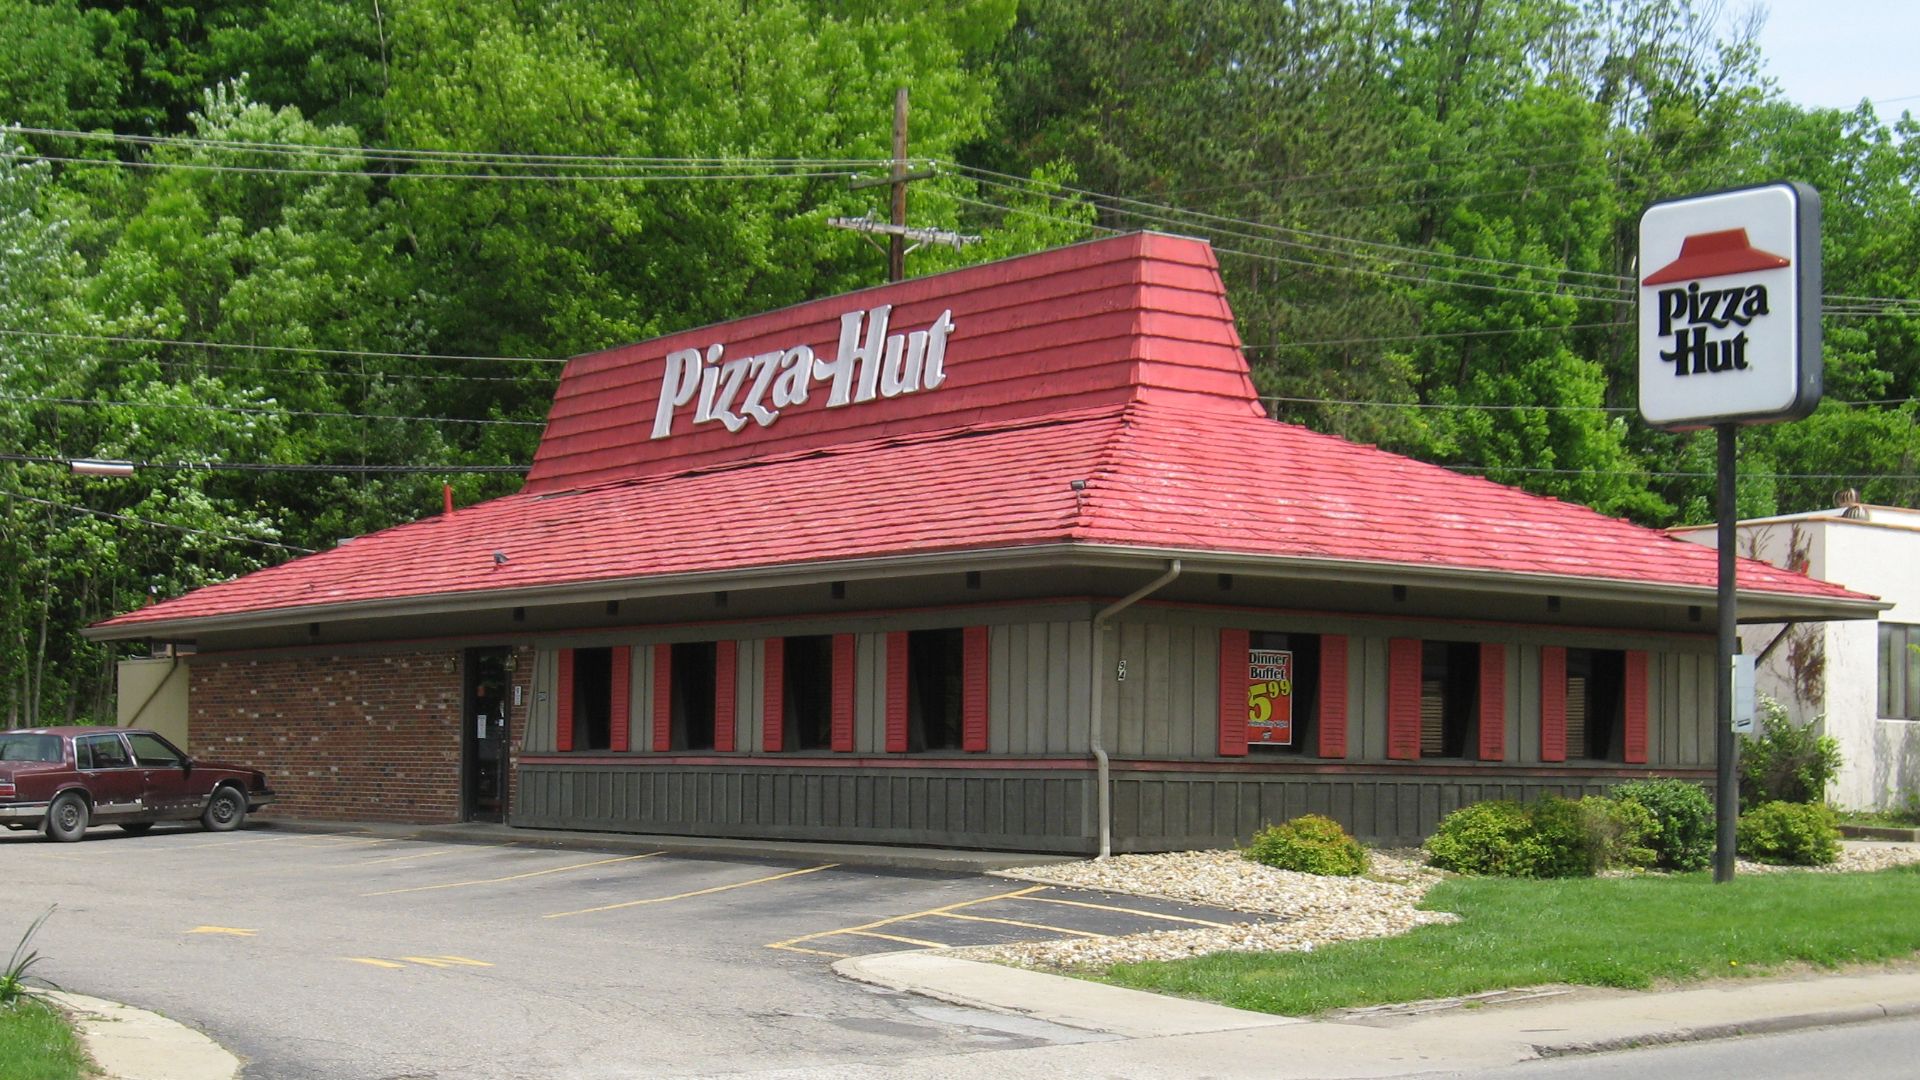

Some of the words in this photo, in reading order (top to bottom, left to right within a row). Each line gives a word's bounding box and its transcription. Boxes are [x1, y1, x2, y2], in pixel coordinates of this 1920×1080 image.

[1658, 281, 1769, 336] Pizza
[650, 343, 814, 439] Pizza
[813, 304, 955, 408] Hut
[1659, 326, 1749, 376] Hut
[1249, 653, 1288, 665] Dinner
[1250, 667, 1286, 680] Buffet
